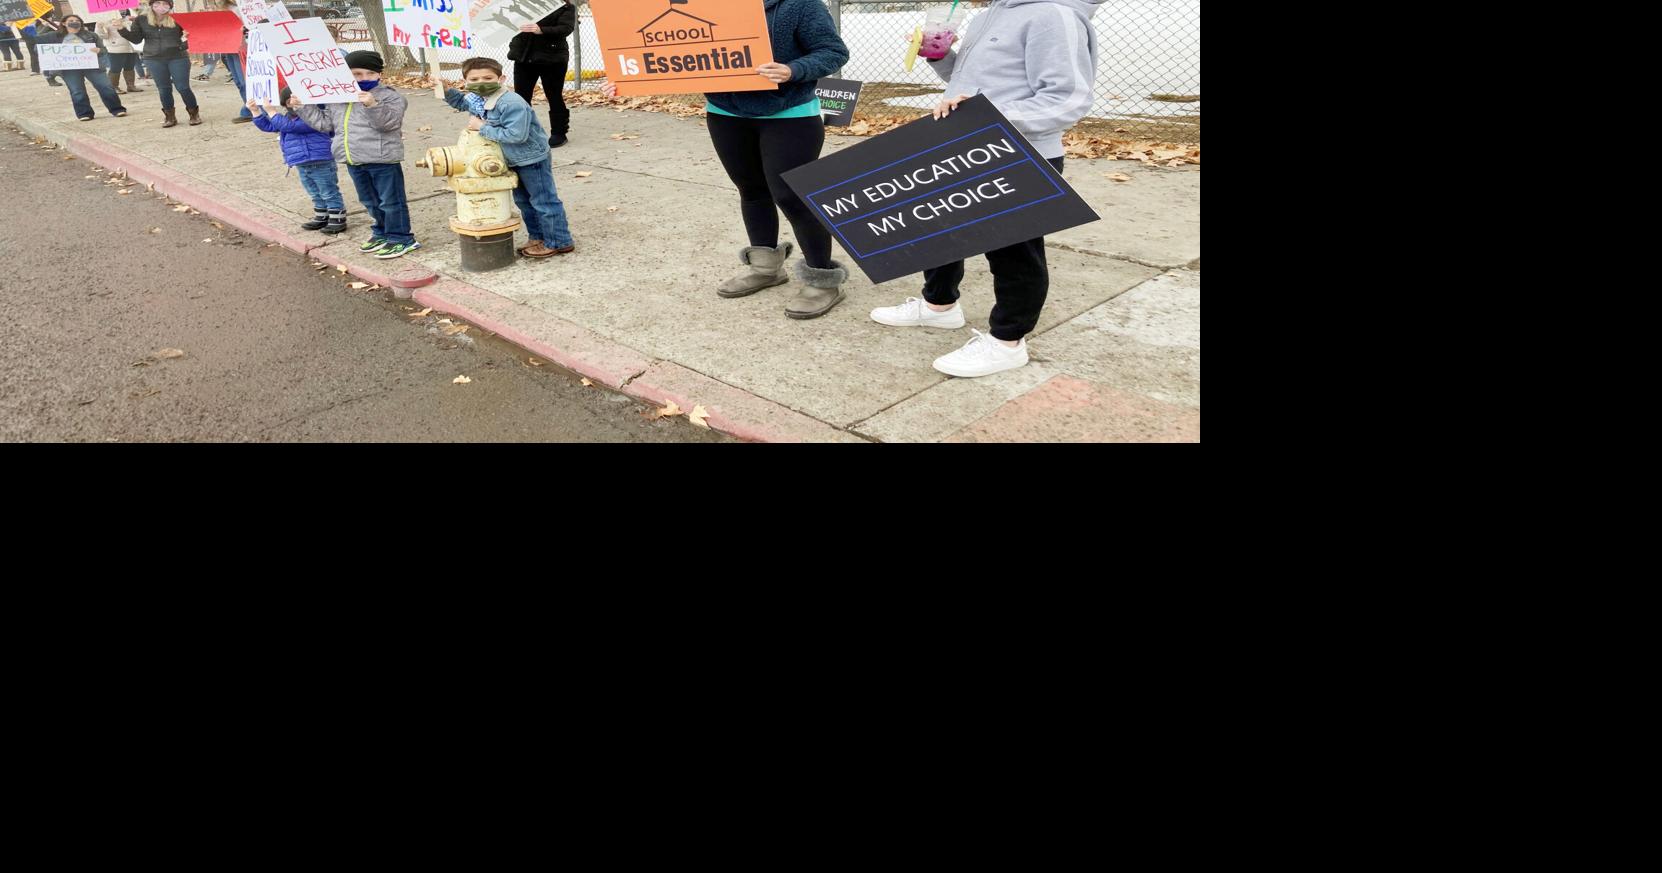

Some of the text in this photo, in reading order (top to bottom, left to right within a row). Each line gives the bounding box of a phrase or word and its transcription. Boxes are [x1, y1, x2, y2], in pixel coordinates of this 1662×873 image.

[274, 20, 310, 44] I
[421, 24, 473, 49] friends
[645, 27, 710, 43] SCHOOL
[41, 45, 86, 54] PUSD
[618, 45, 753, 75] Is Essential
[276, 48, 344, 76] DESERVE
[301, 77, 357, 98] Better
[815, 88, 856, 100] CHILDREN
[820, 98, 847, 110] HOICE
[821, 138, 1016, 218] MY EDUCATION
[867, 177, 1016, 236] MY CHOICE
